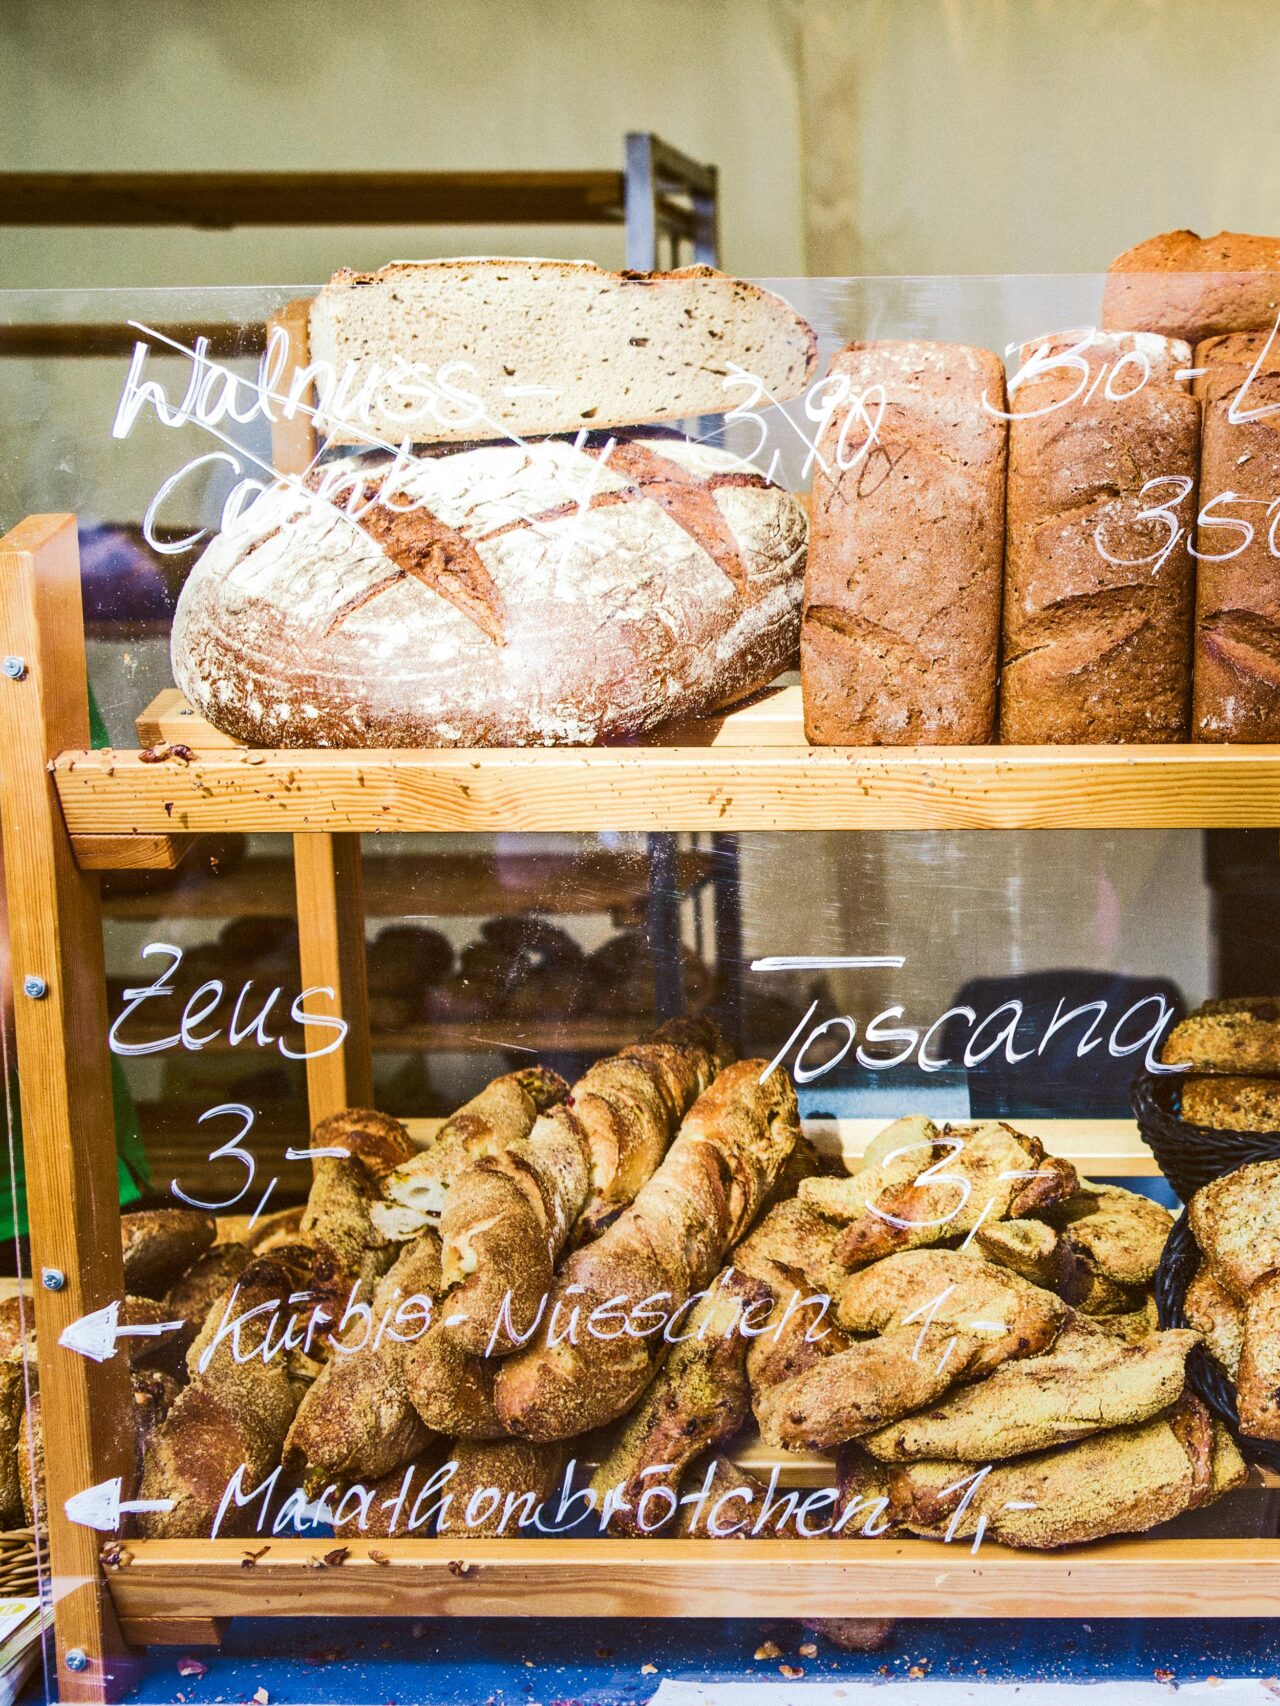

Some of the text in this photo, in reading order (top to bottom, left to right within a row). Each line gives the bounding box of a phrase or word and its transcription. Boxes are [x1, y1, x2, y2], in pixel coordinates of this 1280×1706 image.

[109, 943, 349, 1059] Zeus
[750, 956, 1193, 1085] Toscana
[211, 1459, 891, 1542] Marathonbrötchen
